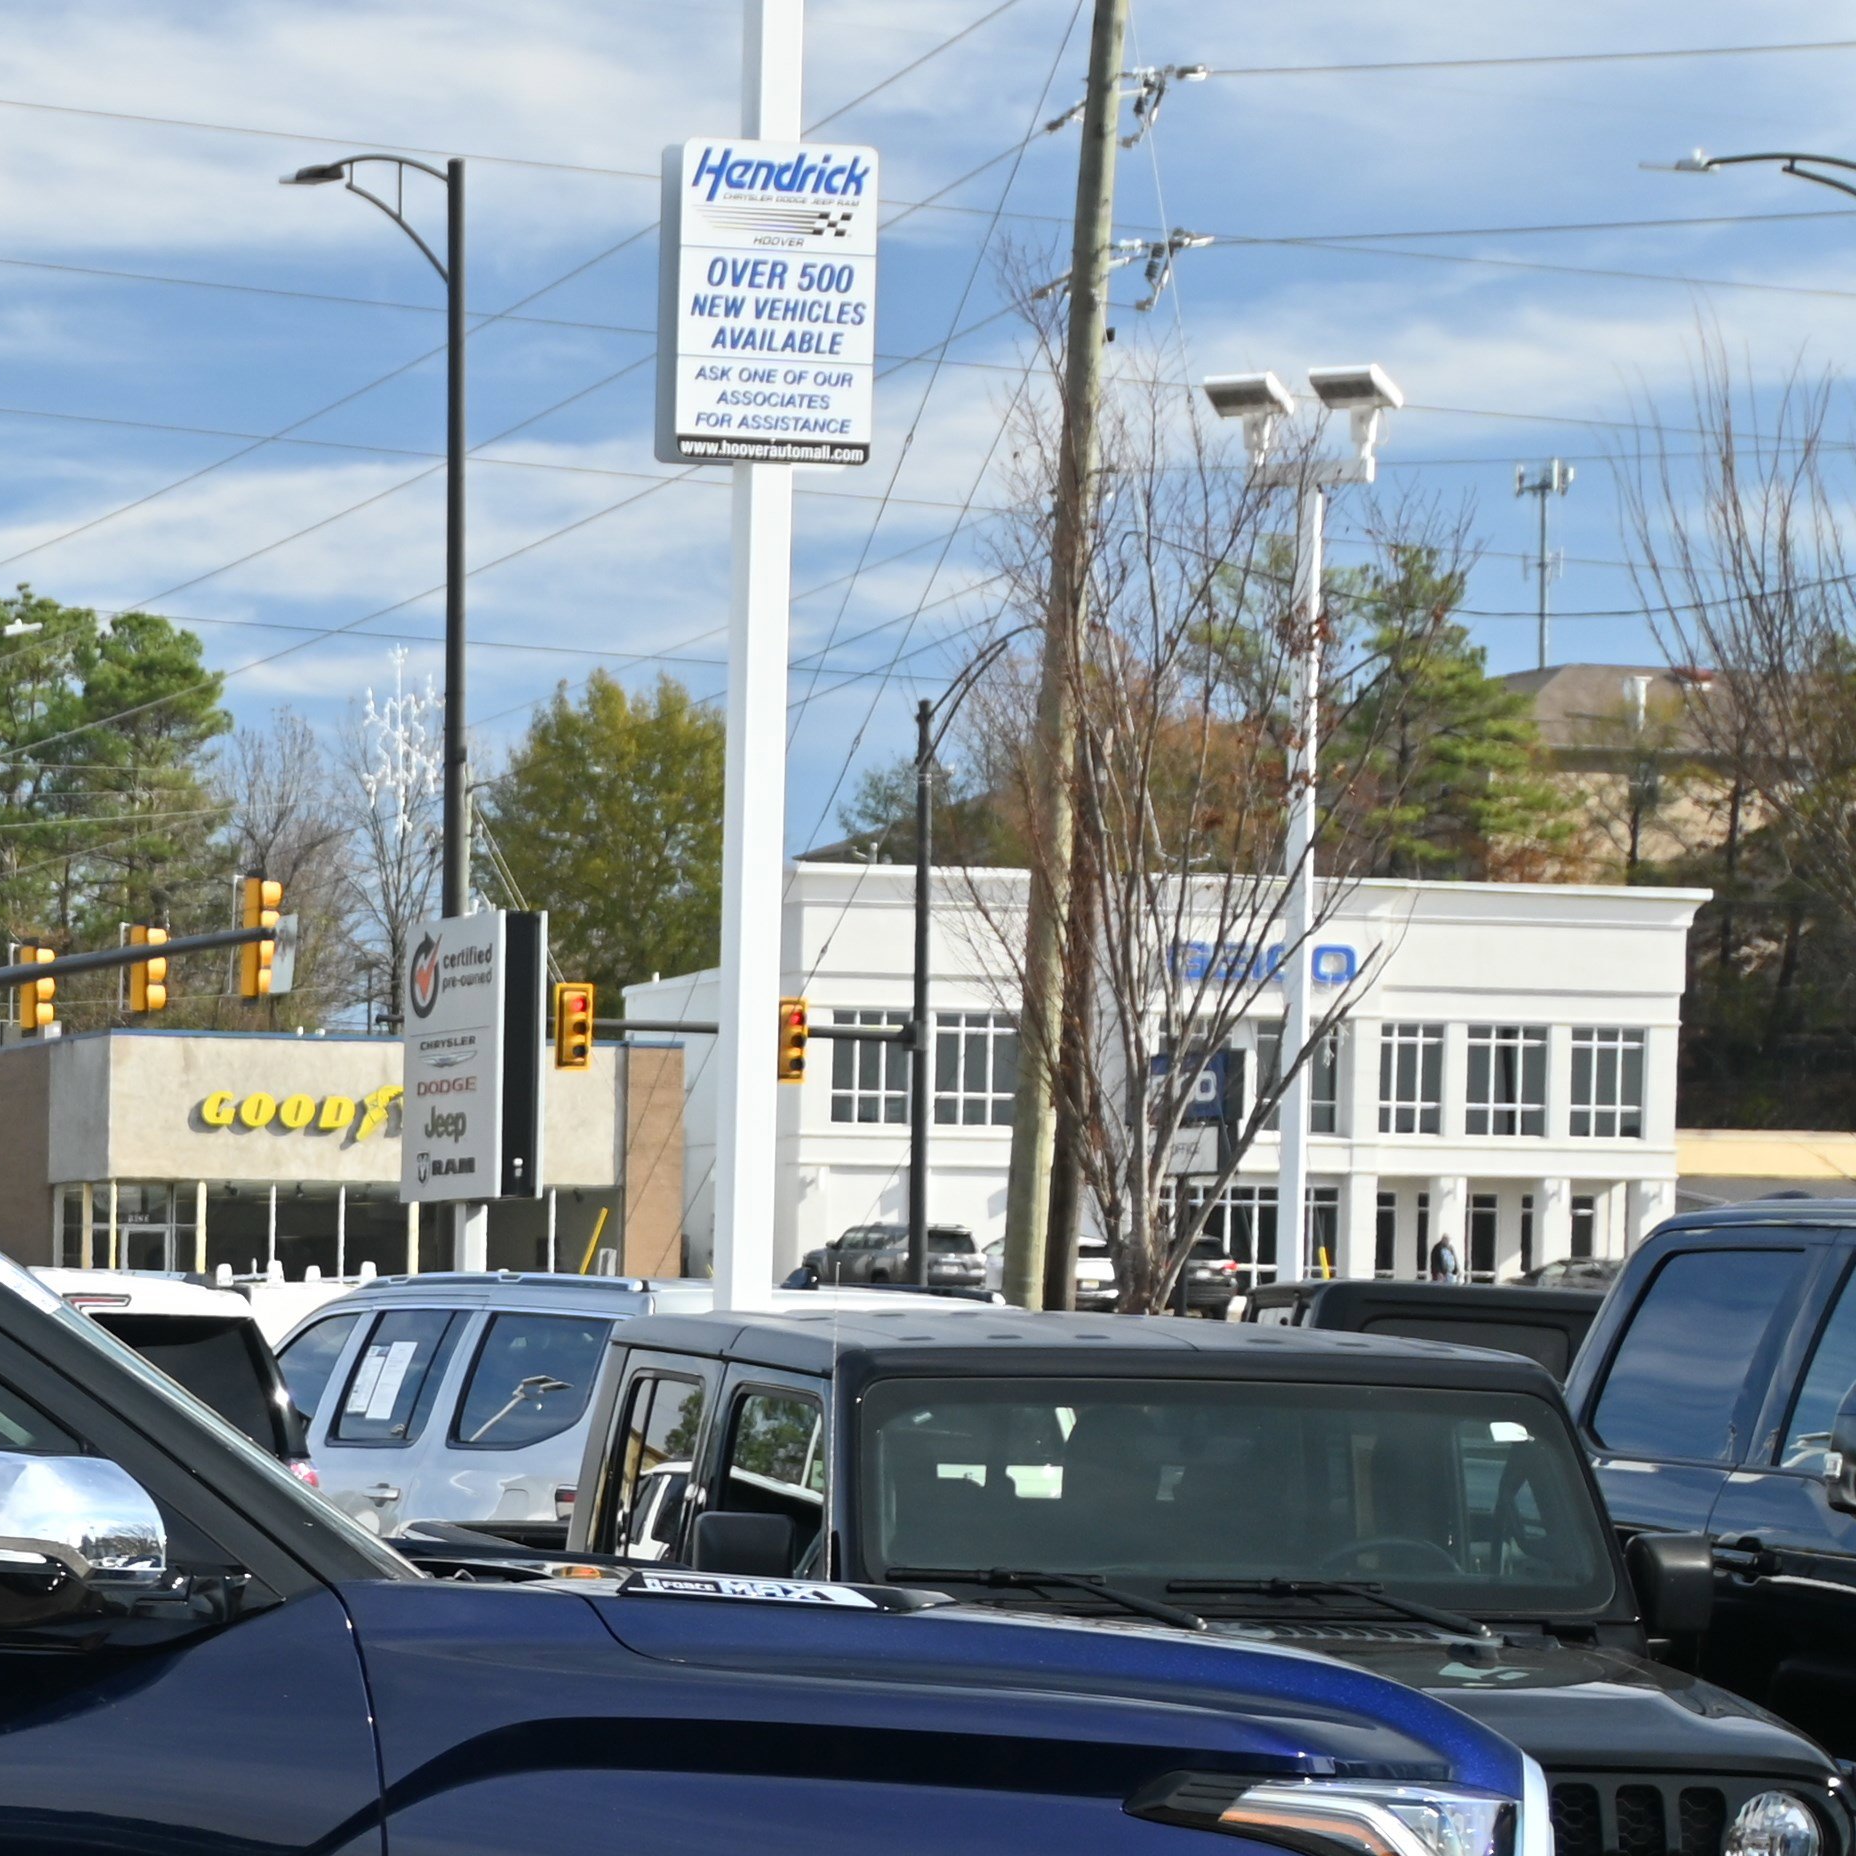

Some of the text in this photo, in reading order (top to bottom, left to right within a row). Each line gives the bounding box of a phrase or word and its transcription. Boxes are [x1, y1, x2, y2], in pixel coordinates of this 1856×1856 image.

[691, 147, 870, 201] Hendrick
[723, 192, 861, 207] CHRYSLER DODGE JEEP RAM
[753, 236, 805, 247] HOOVER
[707, 256, 855, 293] OVER 500
[690, 294, 866, 325] NEW VEHICLES
[711, 326, 844, 355] AVAILABLE
[695, 365, 853, 387] ASK ONE OF OUR
[717, 390, 831, 410] ASSOCIATES
[695, 412, 851, 434] FOR ASSISTANCE
[680, 438, 865, 463] www.hooverautomall.com
[443, 943, 492, 969] certified
[442, 969, 492, 993] pre-owned
[420, 1035, 476, 1051] CHRYSLER
[417, 1076, 477, 1097] DODGE
[425, 1106, 467, 1143] Jeep
[432, 1157, 475, 1176] RAM
[718, 1580, 835, 1601] MAX
